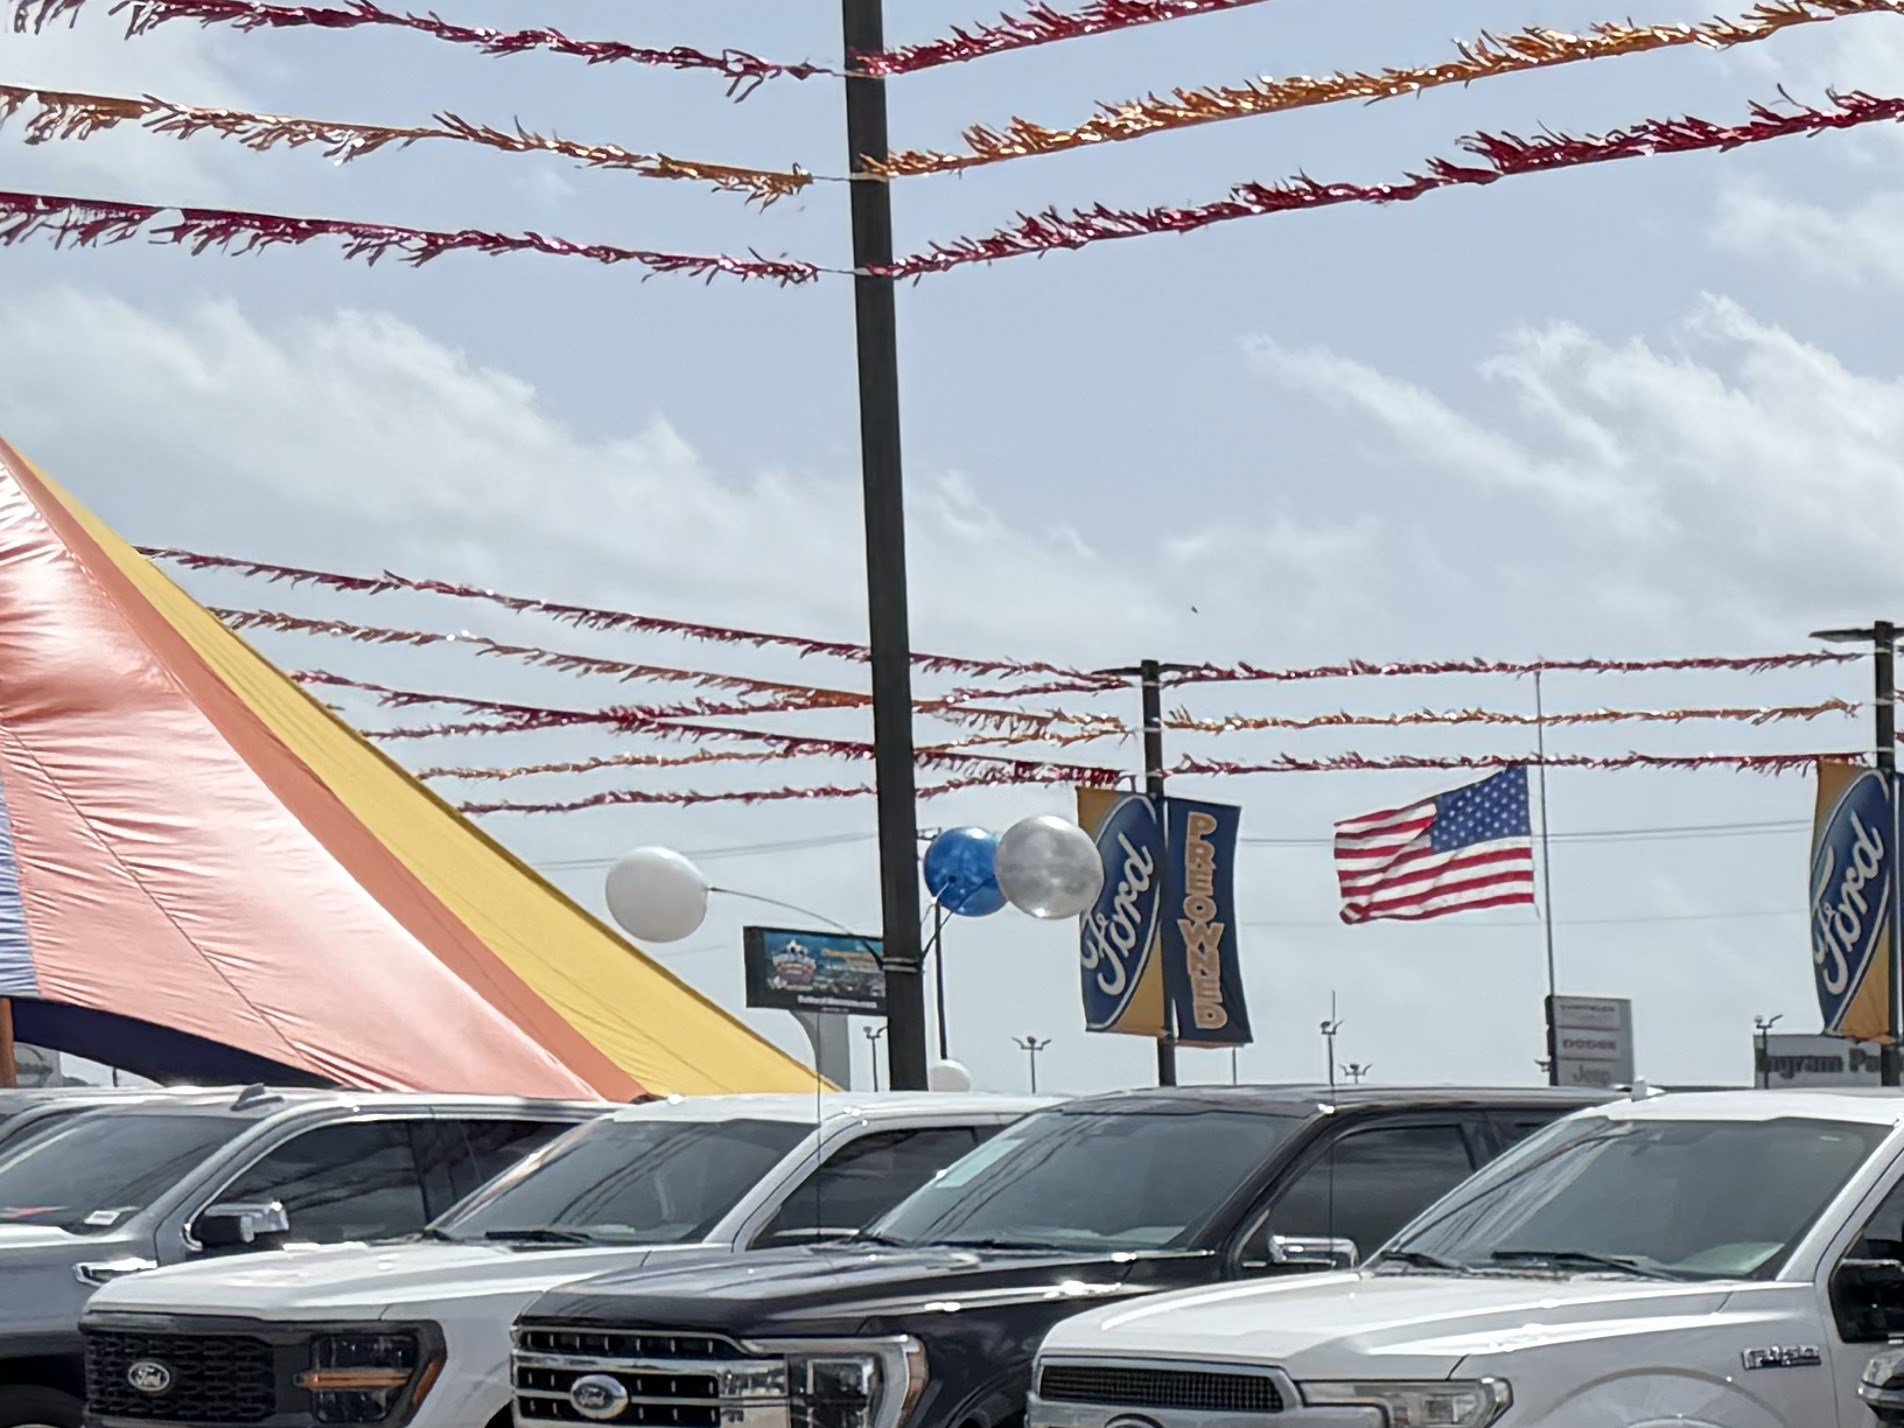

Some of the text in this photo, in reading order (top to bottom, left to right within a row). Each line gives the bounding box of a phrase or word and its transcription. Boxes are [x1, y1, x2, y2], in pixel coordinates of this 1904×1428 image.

[1080, 831, 1154, 996] Ford
[1176, 811, 1229, 1030] PREOWNED
[1811, 809, 1885, 996] Ford
